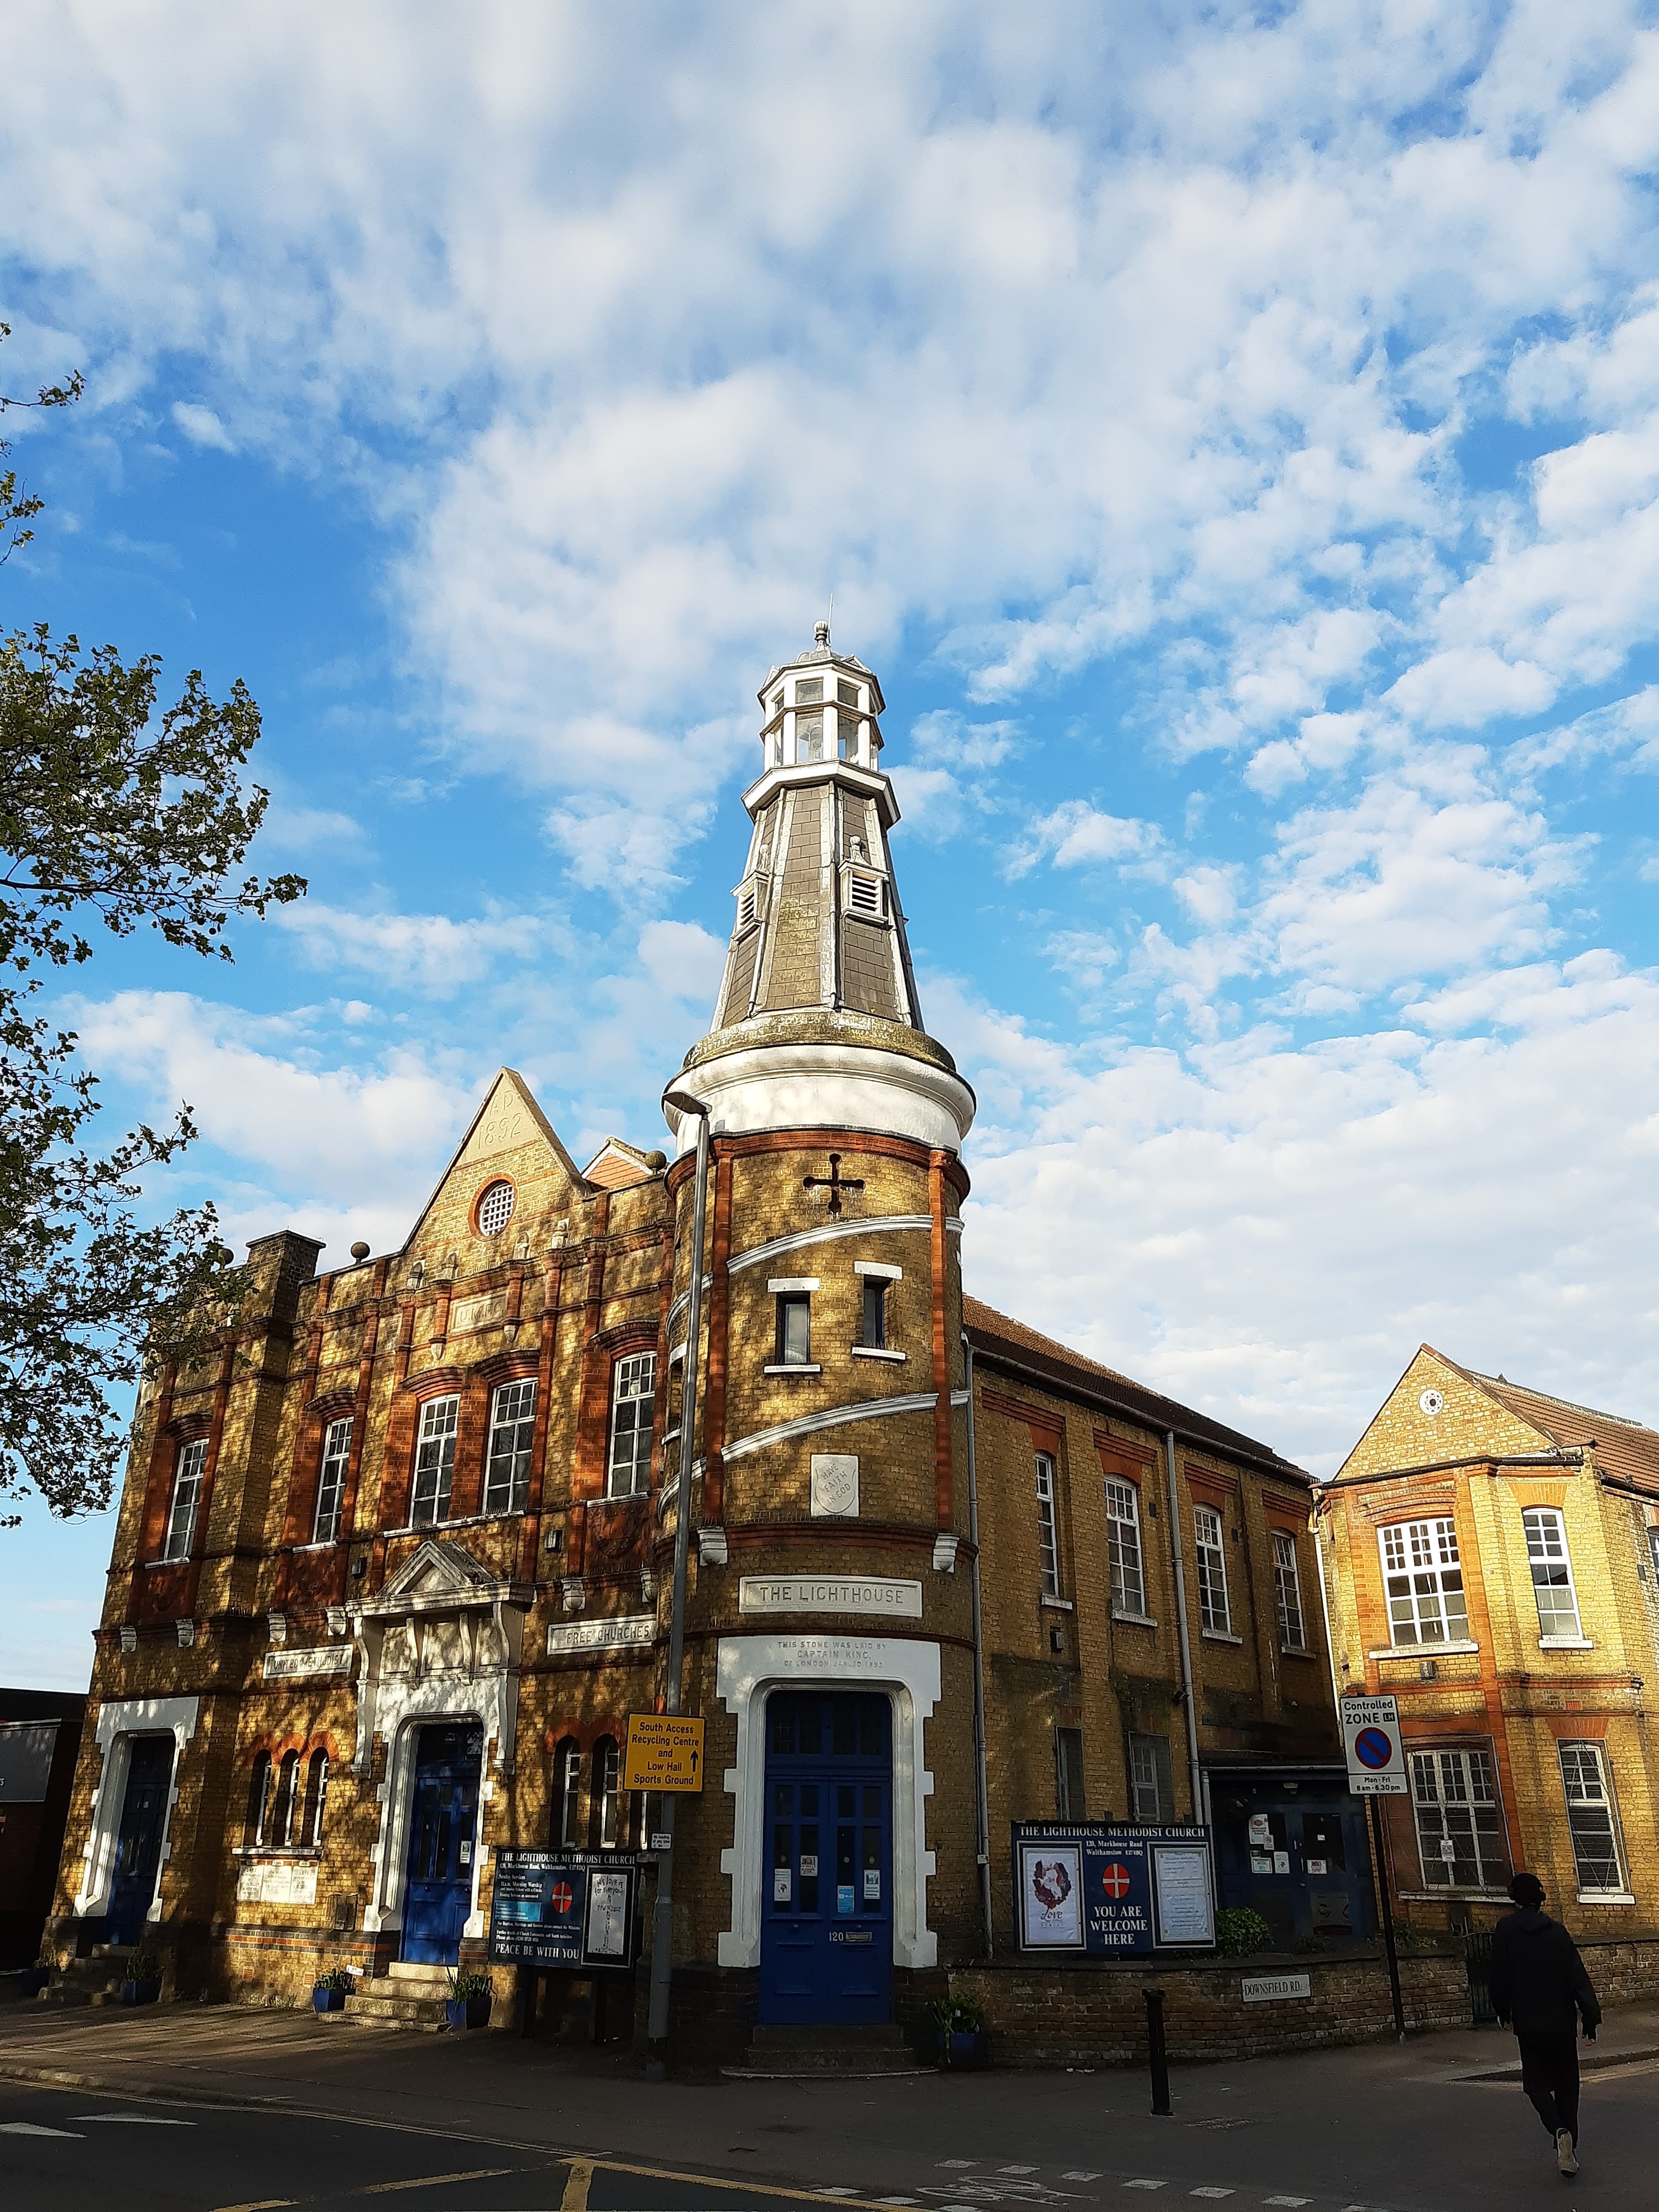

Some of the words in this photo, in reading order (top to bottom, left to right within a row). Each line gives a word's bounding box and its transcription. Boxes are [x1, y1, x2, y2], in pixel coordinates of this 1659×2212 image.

[477, 1112, 522, 1150] 1892
[821, 1463, 839, 1480] HAVE
[823, 1470, 848, 1493] FAITH
[827, 1495, 837, 1505] IN
[759, 1586, 792, 1602] THE
[566, 1630, 592, 1644] FREE
[597, 1625, 650, 1641] CHURCHES
[797, 1650, 839, 1658] CAPTAIN
[274, 1659, 298, 1670] UNITED
[299, 1653, 343, 1668] METHODIST
[1344, 1699, 1393, 1710] Controlled
[1345, 1712, 1380, 1725] ZONE
[1384, 1713, 1394, 1721] LH
[639, 1721, 663, 1732] South
[666, 1723, 694, 1734] Access
[632, 1734, 670, 1746] Recycling
[673, 1736, 700, 1746] Centre
[658, 1748, 673, 1758] and
[647, 1761, 664, 1771] Low
[666, 1761, 682, 1771] Hall
[634, 1773, 661, 1785] Sports
[665, 1774, 694, 1785] Ground
[1019, 1826, 1040, 1836] THE
[1043, 1827, 1105, 1837] LIGHTHOUSE
[1108, 1827, 1163, 1837] METHODIST
[1165, 1827, 1204, 1837] CHURCH
[501, 1853, 514, 1861] THE
[516, 1853, 559, 1863] LIGHTHOUSE
[561, 1853, 603, 1864] METHODIST
[604, 1855, 635, 1865] CHURCH
[1094, 1906, 1117, 1918] YOU
[1120, 1906, 1142, 1917] ARE
[1089, 1919, 1148, 1932] WELCOME
[829, 1932, 844, 1942] 120
[1104, 1933, 1135, 1945] HERE
[495, 1943, 520, 1955] PEACE
[523, 1945, 534, 1956] BE
[536, 1945, 559, 1958] WITH
[562, 1948, 580, 1959] YOU
[1244, 1981, 1288, 1996] DOWNSFIELD
